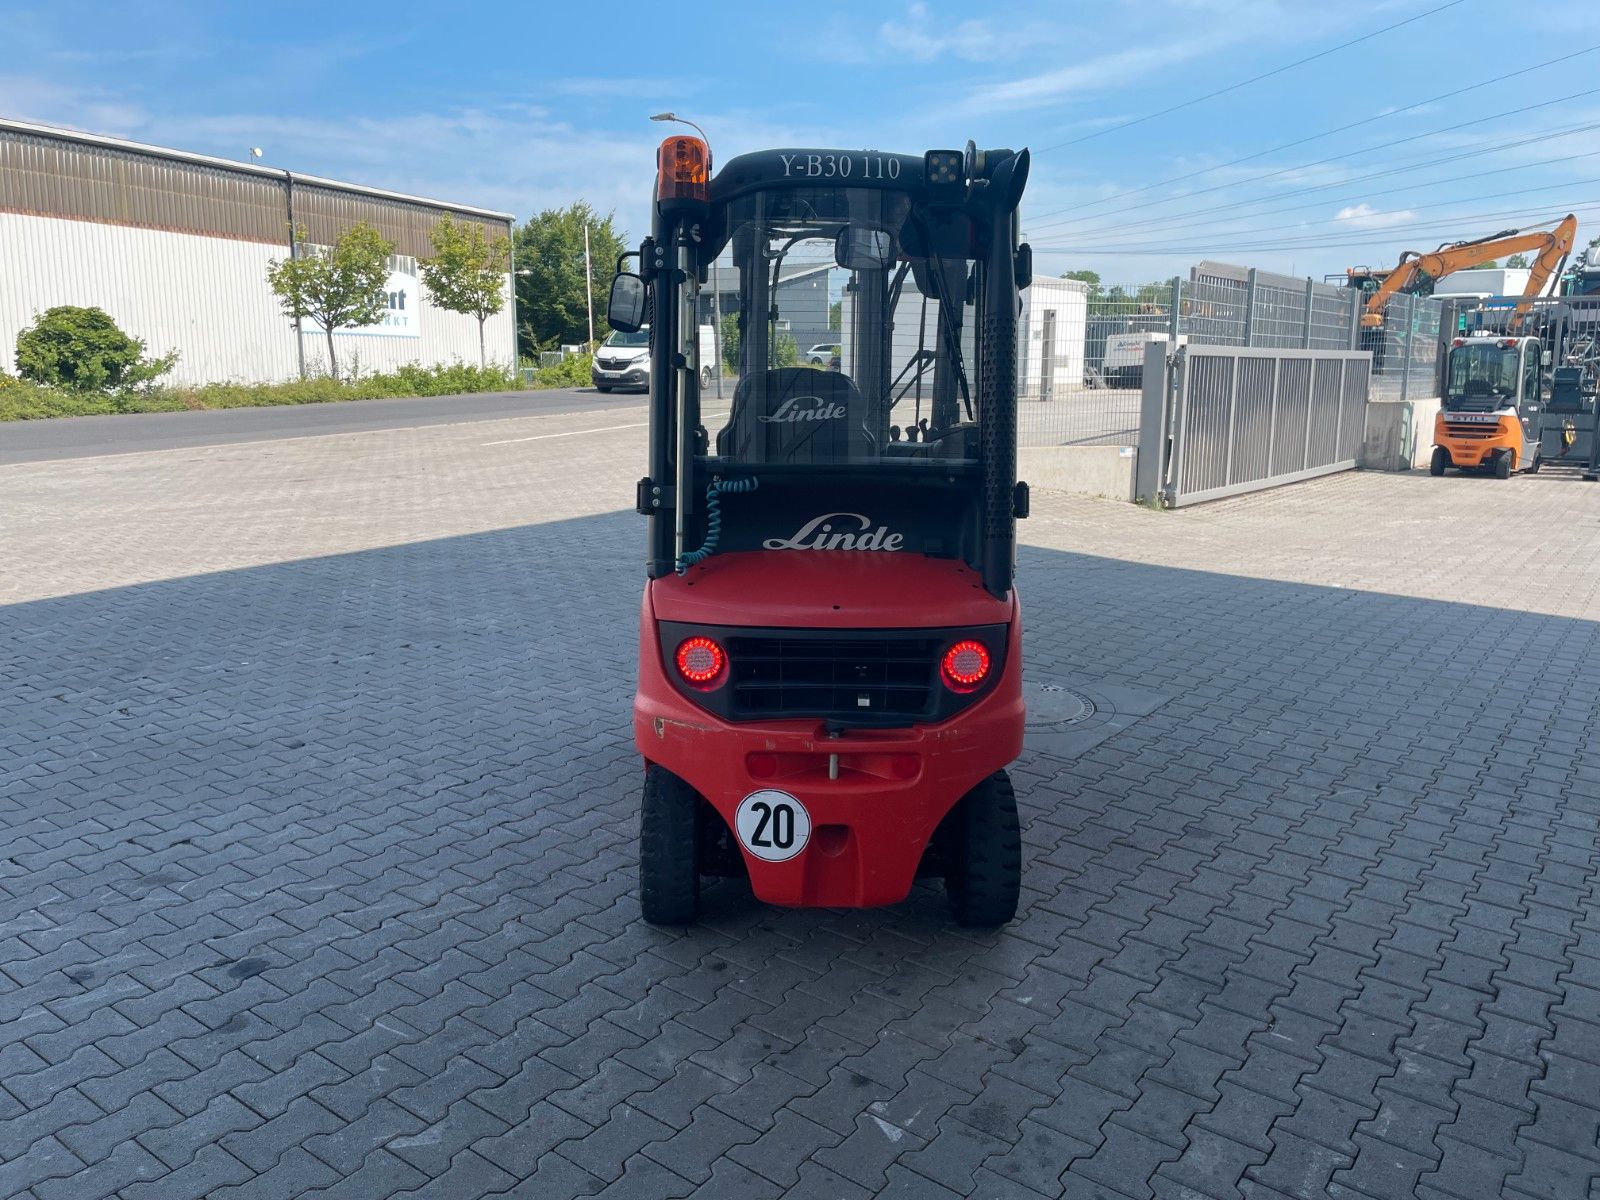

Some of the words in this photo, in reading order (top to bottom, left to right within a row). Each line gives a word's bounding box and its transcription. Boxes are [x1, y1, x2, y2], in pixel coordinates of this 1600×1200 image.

[779, 154, 852, 177] Y-B30
[862, 156, 900, 179] 110
[757, 396, 846, 422] Linde
[762, 512, 904, 551] Linde
[751, 802, 794, 849] 20
